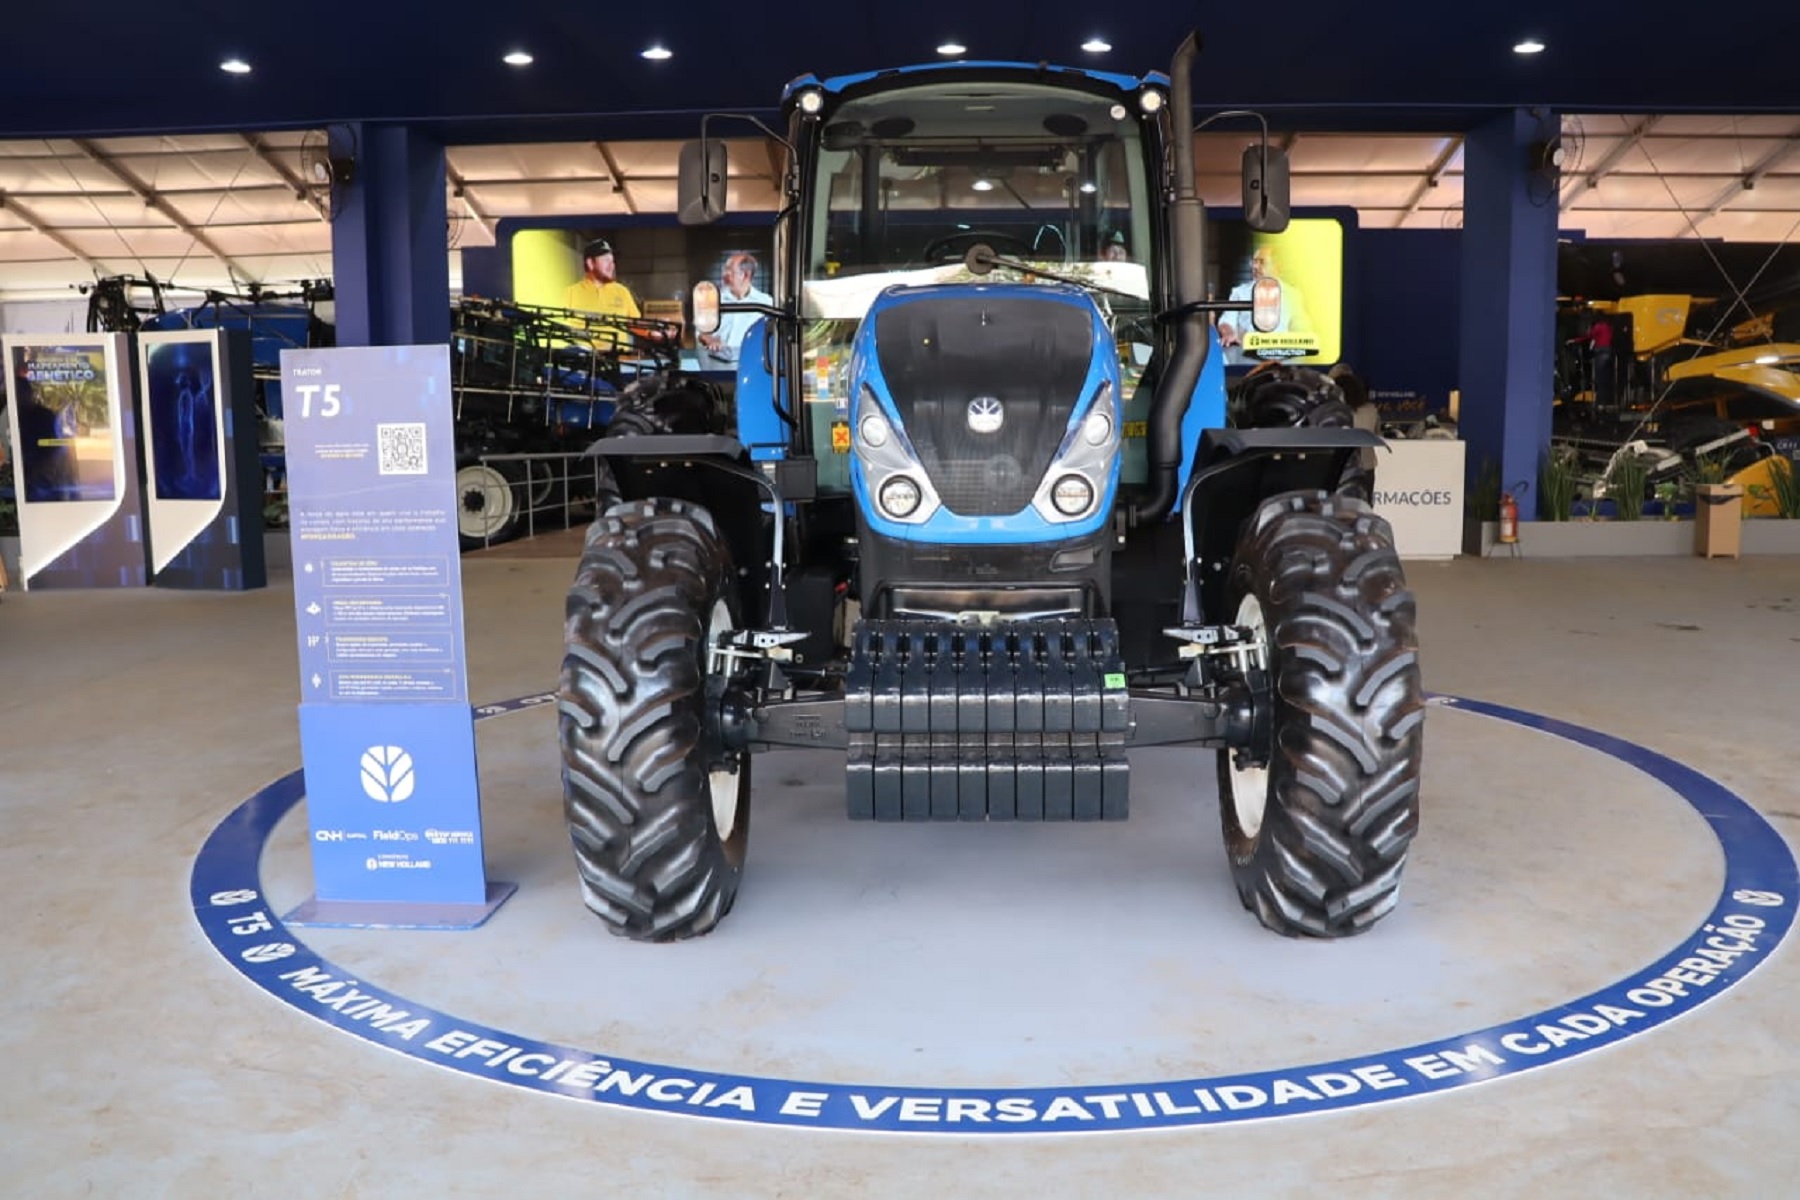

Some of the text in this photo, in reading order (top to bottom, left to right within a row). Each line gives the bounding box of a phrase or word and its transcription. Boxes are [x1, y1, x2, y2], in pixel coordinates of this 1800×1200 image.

[295, 384, 341, 417] T5
[1373, 488, 1452, 506] RMAÇÕES
[315, 830, 343, 841] CNH
[373, 830, 419, 842] FieldOps
[227, 911, 1766, 1123] T5 MÁXIMA EFICIÊNCIA E VERSATILIDADE EM CADA OPERAÇÃO
